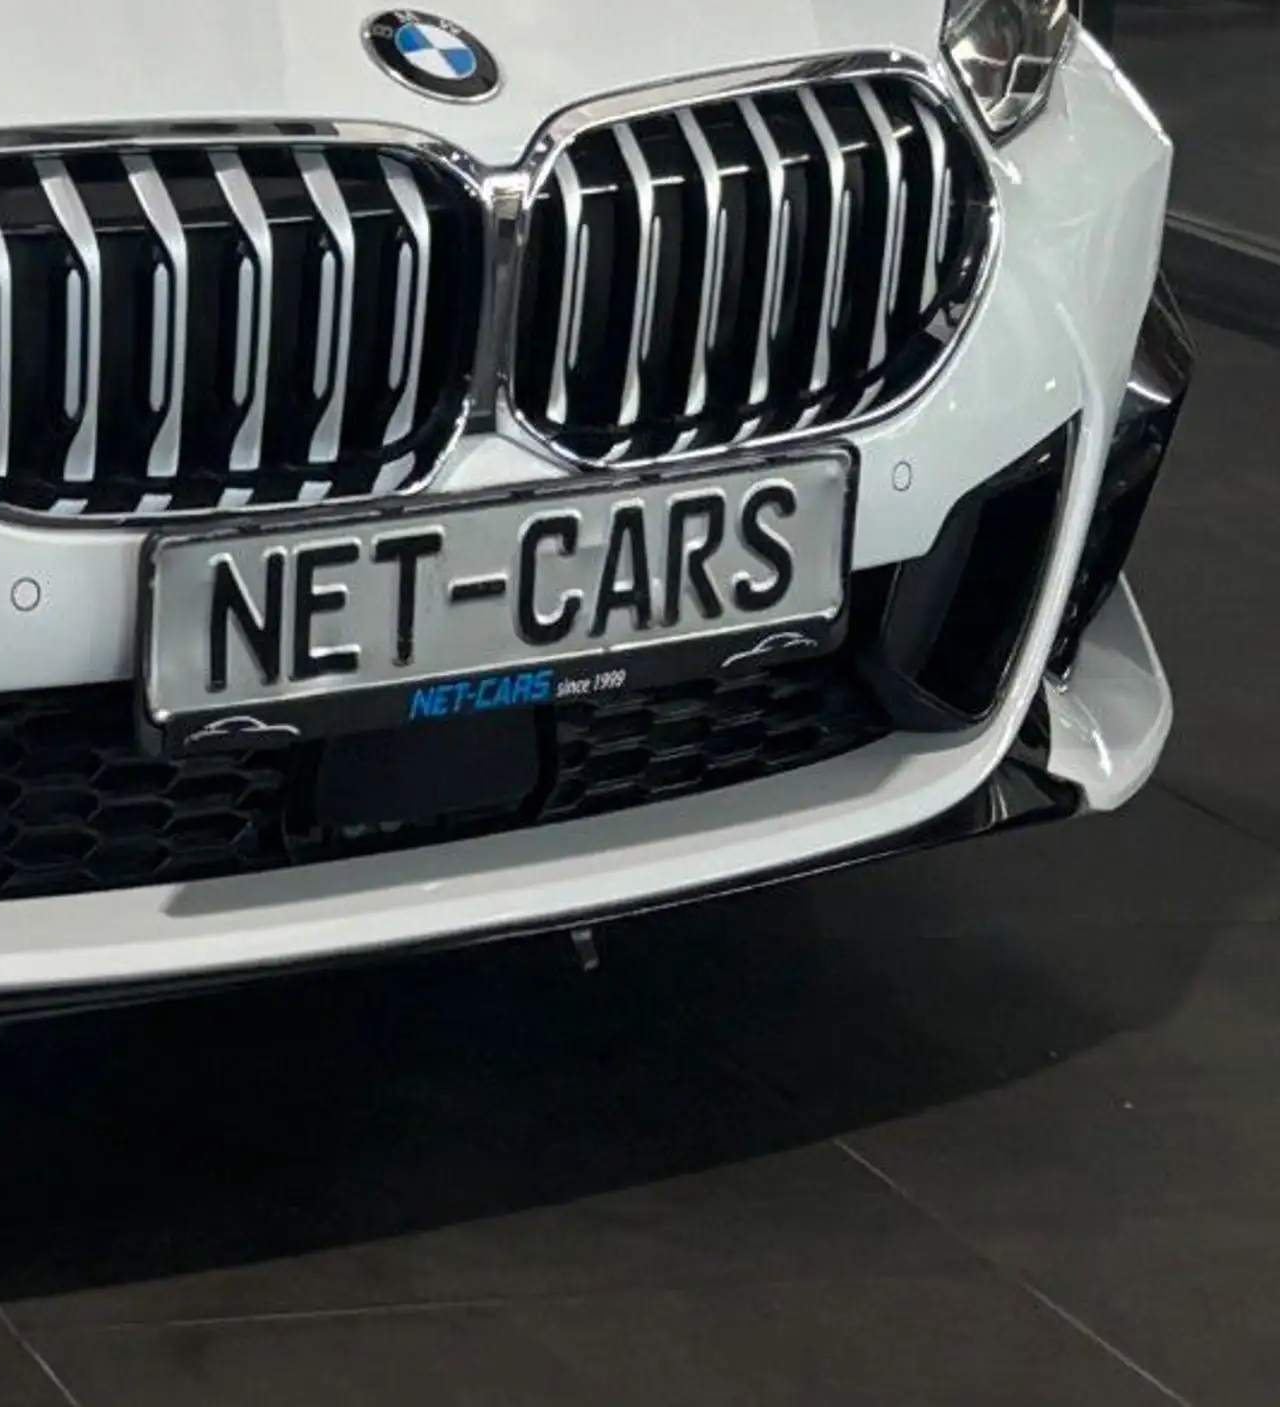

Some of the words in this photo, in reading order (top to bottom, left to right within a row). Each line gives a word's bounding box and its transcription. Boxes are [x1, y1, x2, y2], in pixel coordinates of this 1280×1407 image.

[206, 479, 797, 692] NET-CARS
[409, 668, 554, 721] NET-CARS
[556, 678, 591, 698] since
[593, 668, 627, 691] 1999
